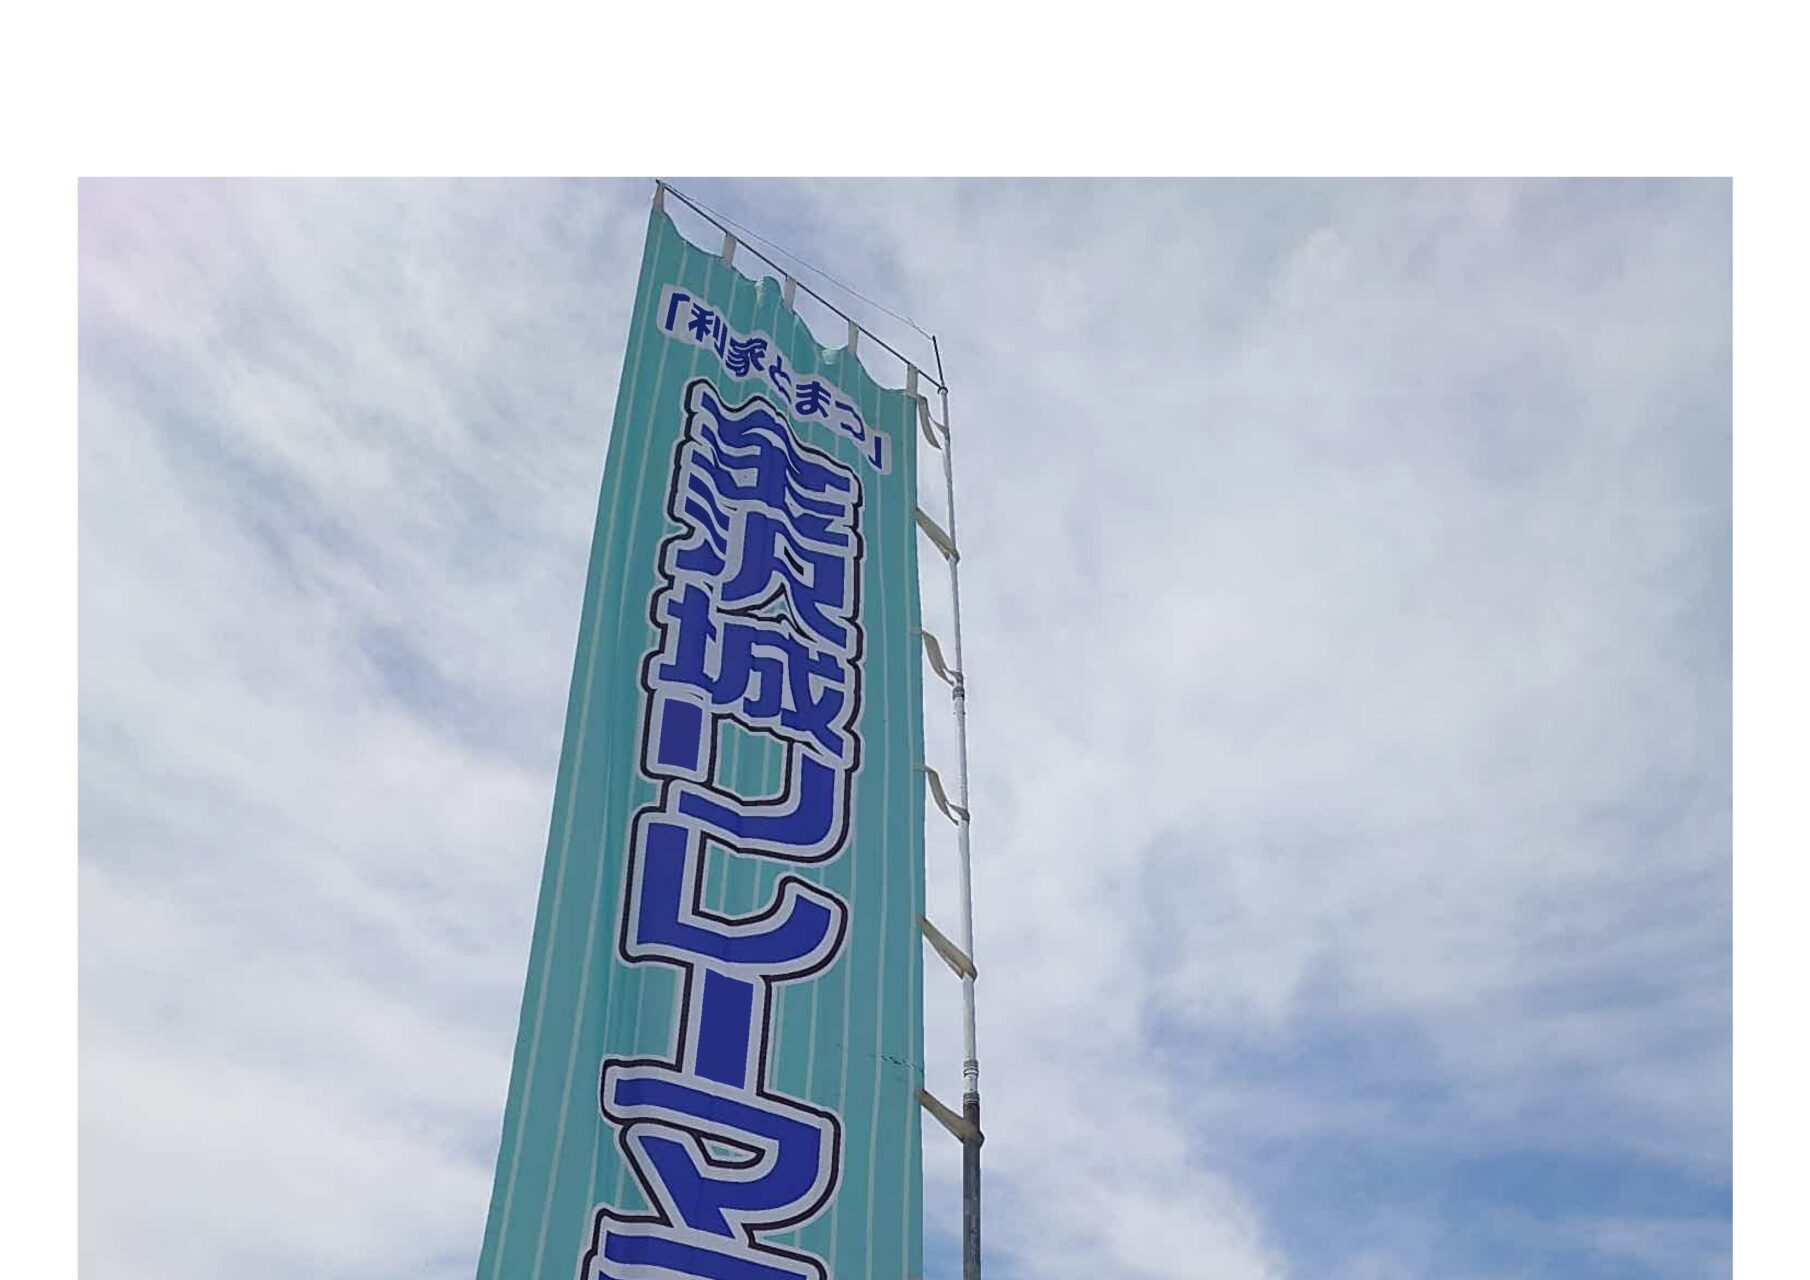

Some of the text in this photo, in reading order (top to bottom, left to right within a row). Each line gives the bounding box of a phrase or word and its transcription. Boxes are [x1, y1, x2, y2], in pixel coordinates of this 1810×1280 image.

[665, 290, 886, 472] 「利家とまつ」
